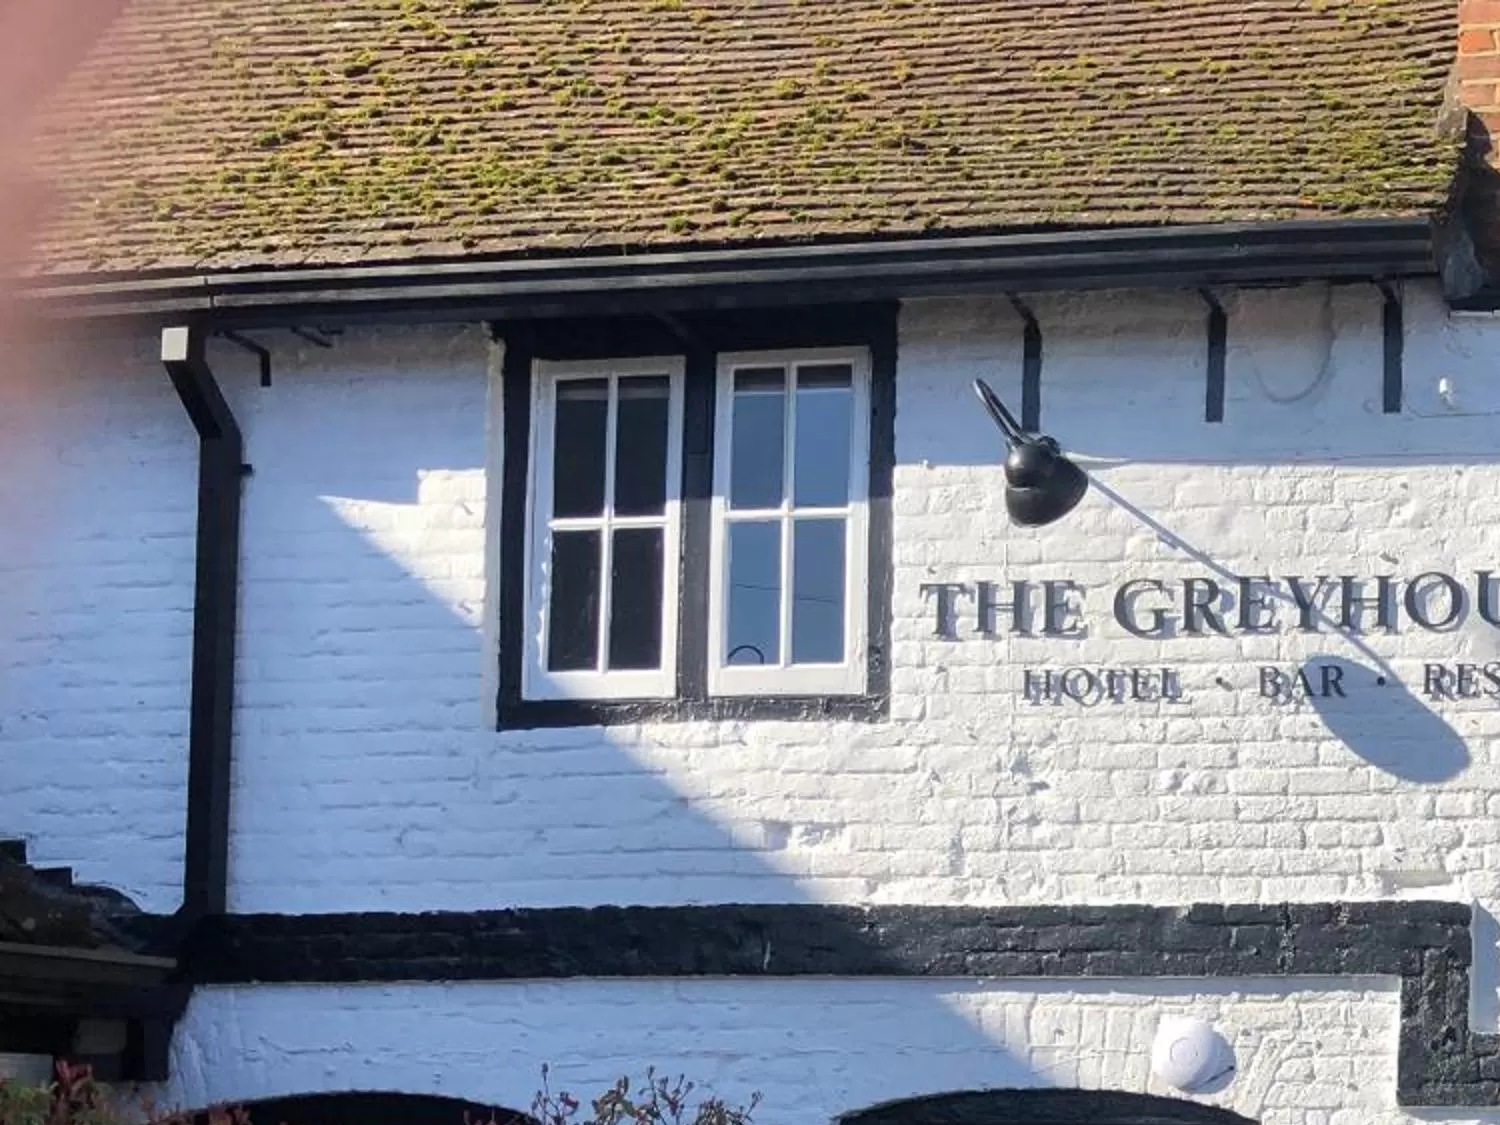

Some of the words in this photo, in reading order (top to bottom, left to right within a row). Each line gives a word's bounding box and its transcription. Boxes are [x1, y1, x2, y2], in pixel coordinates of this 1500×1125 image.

[920, 578, 1082, 637] THE
[1023, 667, 1182, 701] HOTEL
[1259, 664, 1347, 698] BAR
